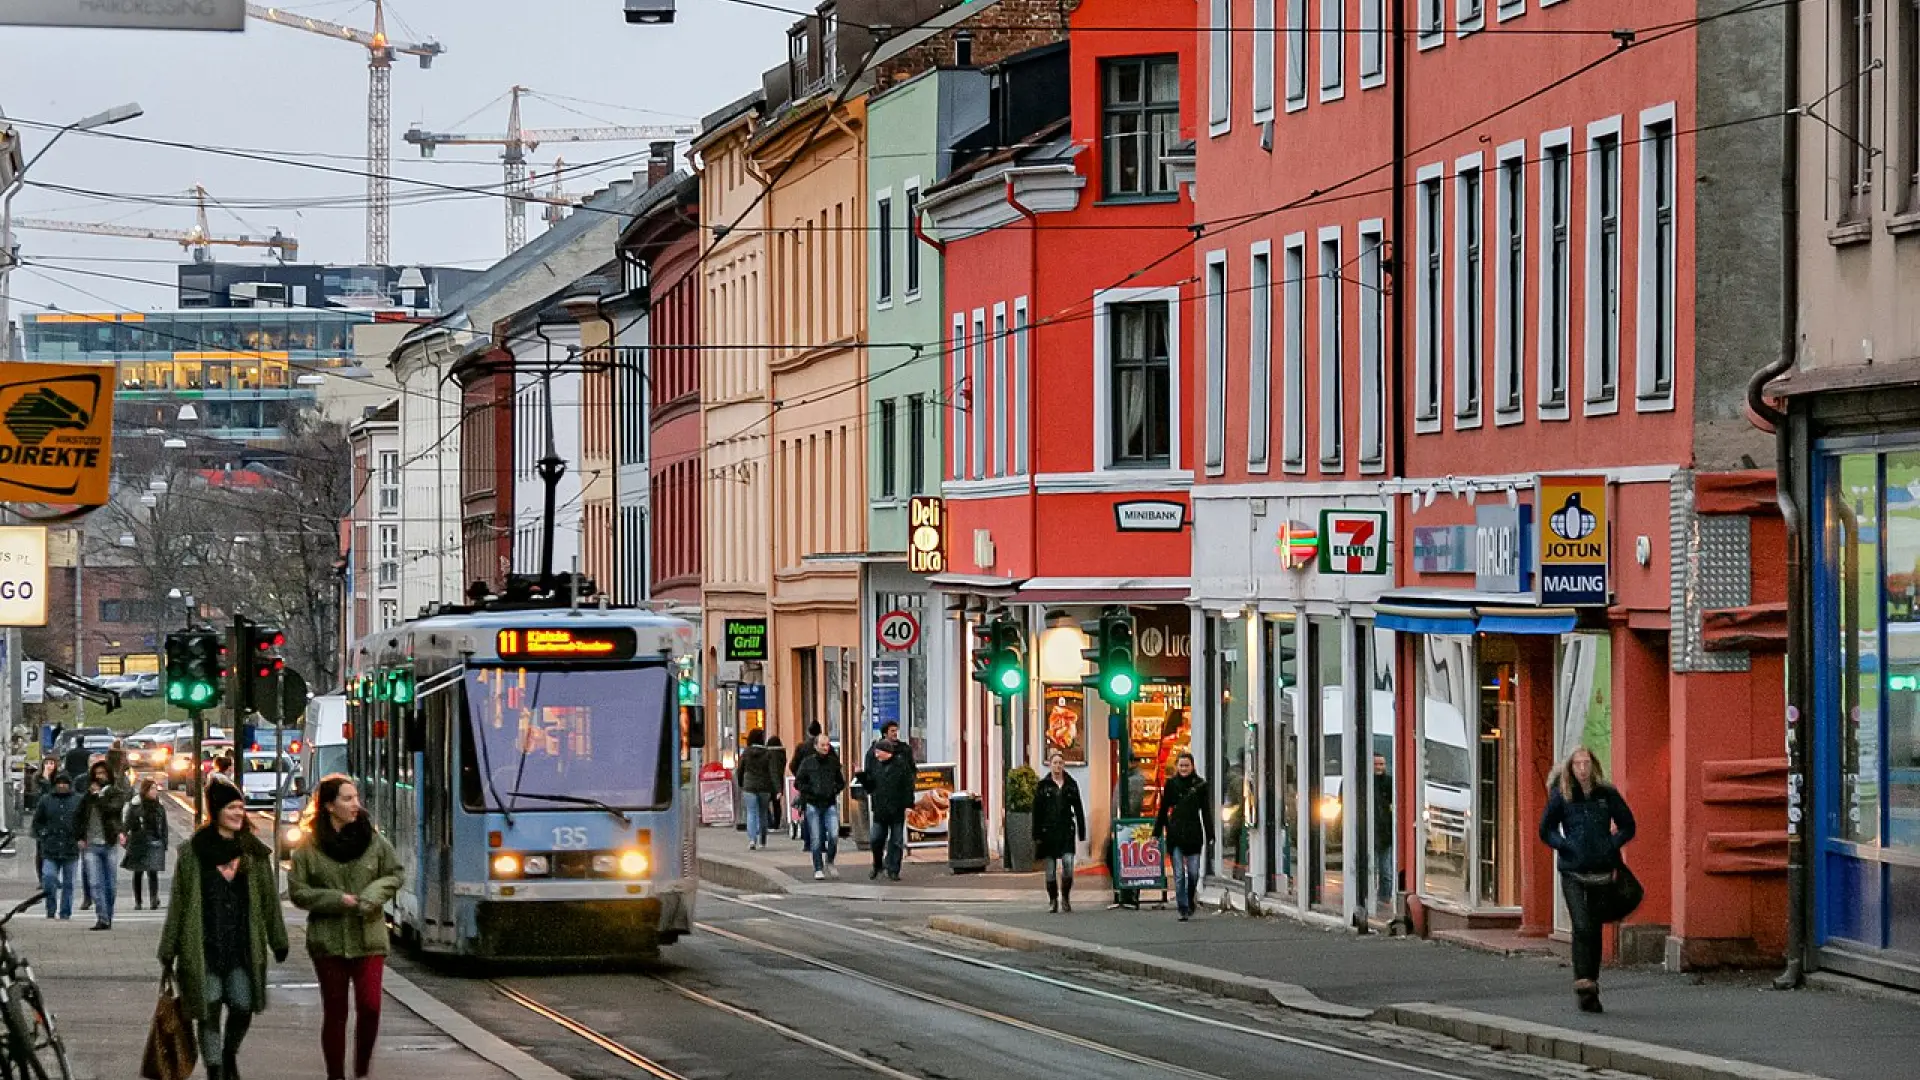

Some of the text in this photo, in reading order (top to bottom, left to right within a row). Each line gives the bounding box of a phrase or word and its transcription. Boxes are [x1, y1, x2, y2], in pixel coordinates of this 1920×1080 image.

[0, 444, 99, 467] DIREKTE
[912, 498, 940, 527] Deli
[1124, 510, 1177, 520] MINIBANK
[1335, 520, 1374, 573] 7
[1546, 543, 1602, 557] JOTUN
[911, 543, 941, 572] Luca
[1545, 577, 1603, 592] MALING
[729, 622, 765, 635] Noma
[884, 621, 911, 640] 40
[500, 630, 517, 653] 11
[734, 636, 760, 649] Grill
[27, 671, 38, 688] P
[552, 826, 588, 848] 135
[1120, 840, 1161, 868] 116
